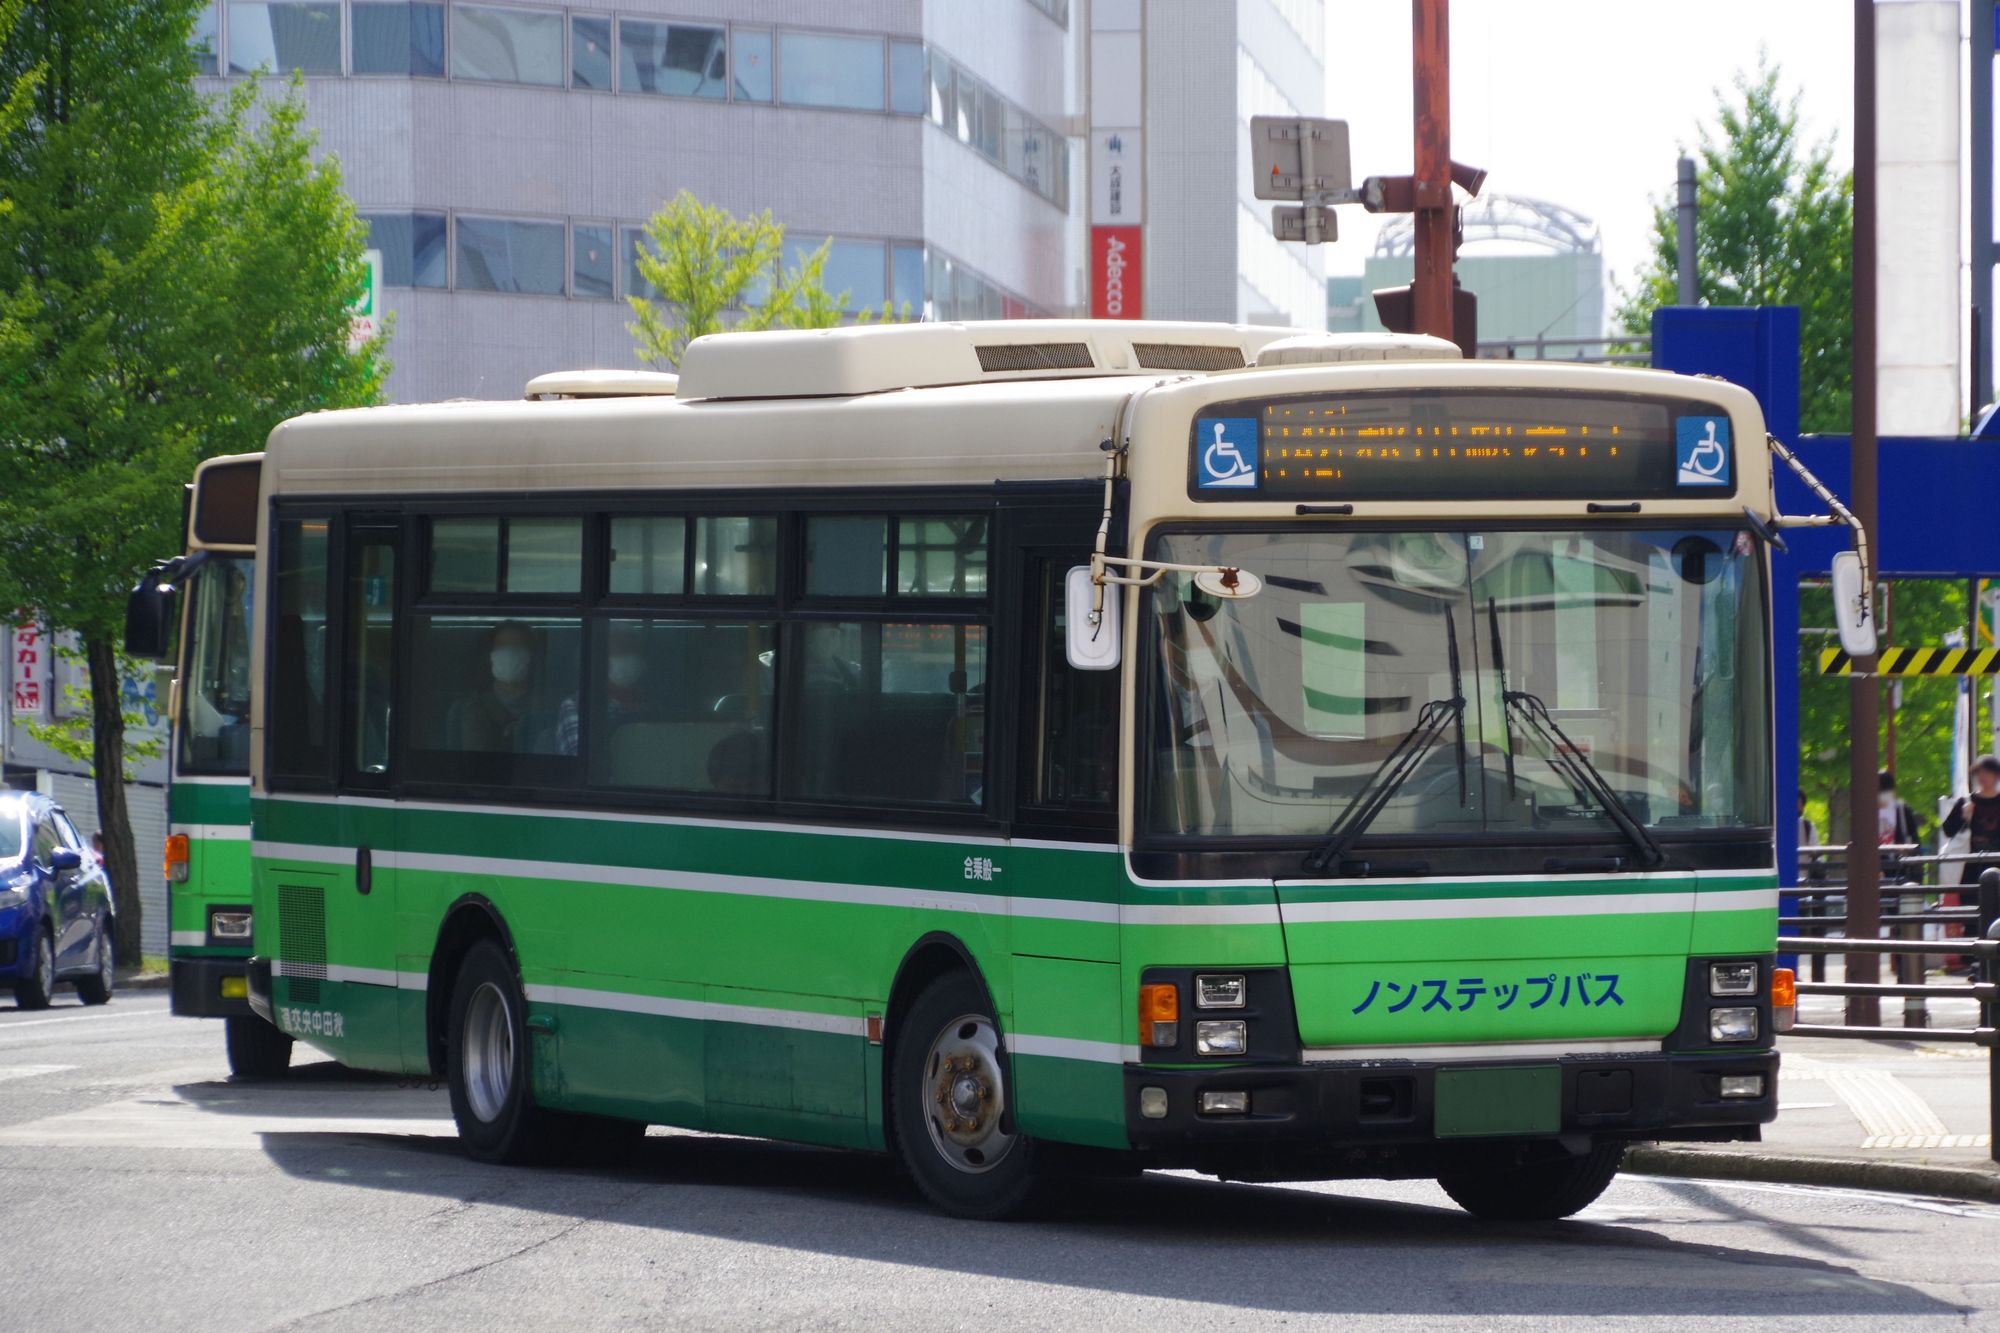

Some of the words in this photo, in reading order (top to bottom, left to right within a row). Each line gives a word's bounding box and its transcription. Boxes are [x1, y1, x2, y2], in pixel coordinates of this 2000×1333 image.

[1107, 235, 1127, 315] Adecco
[1351, 973, 1625, 1015] ノンステップバス
